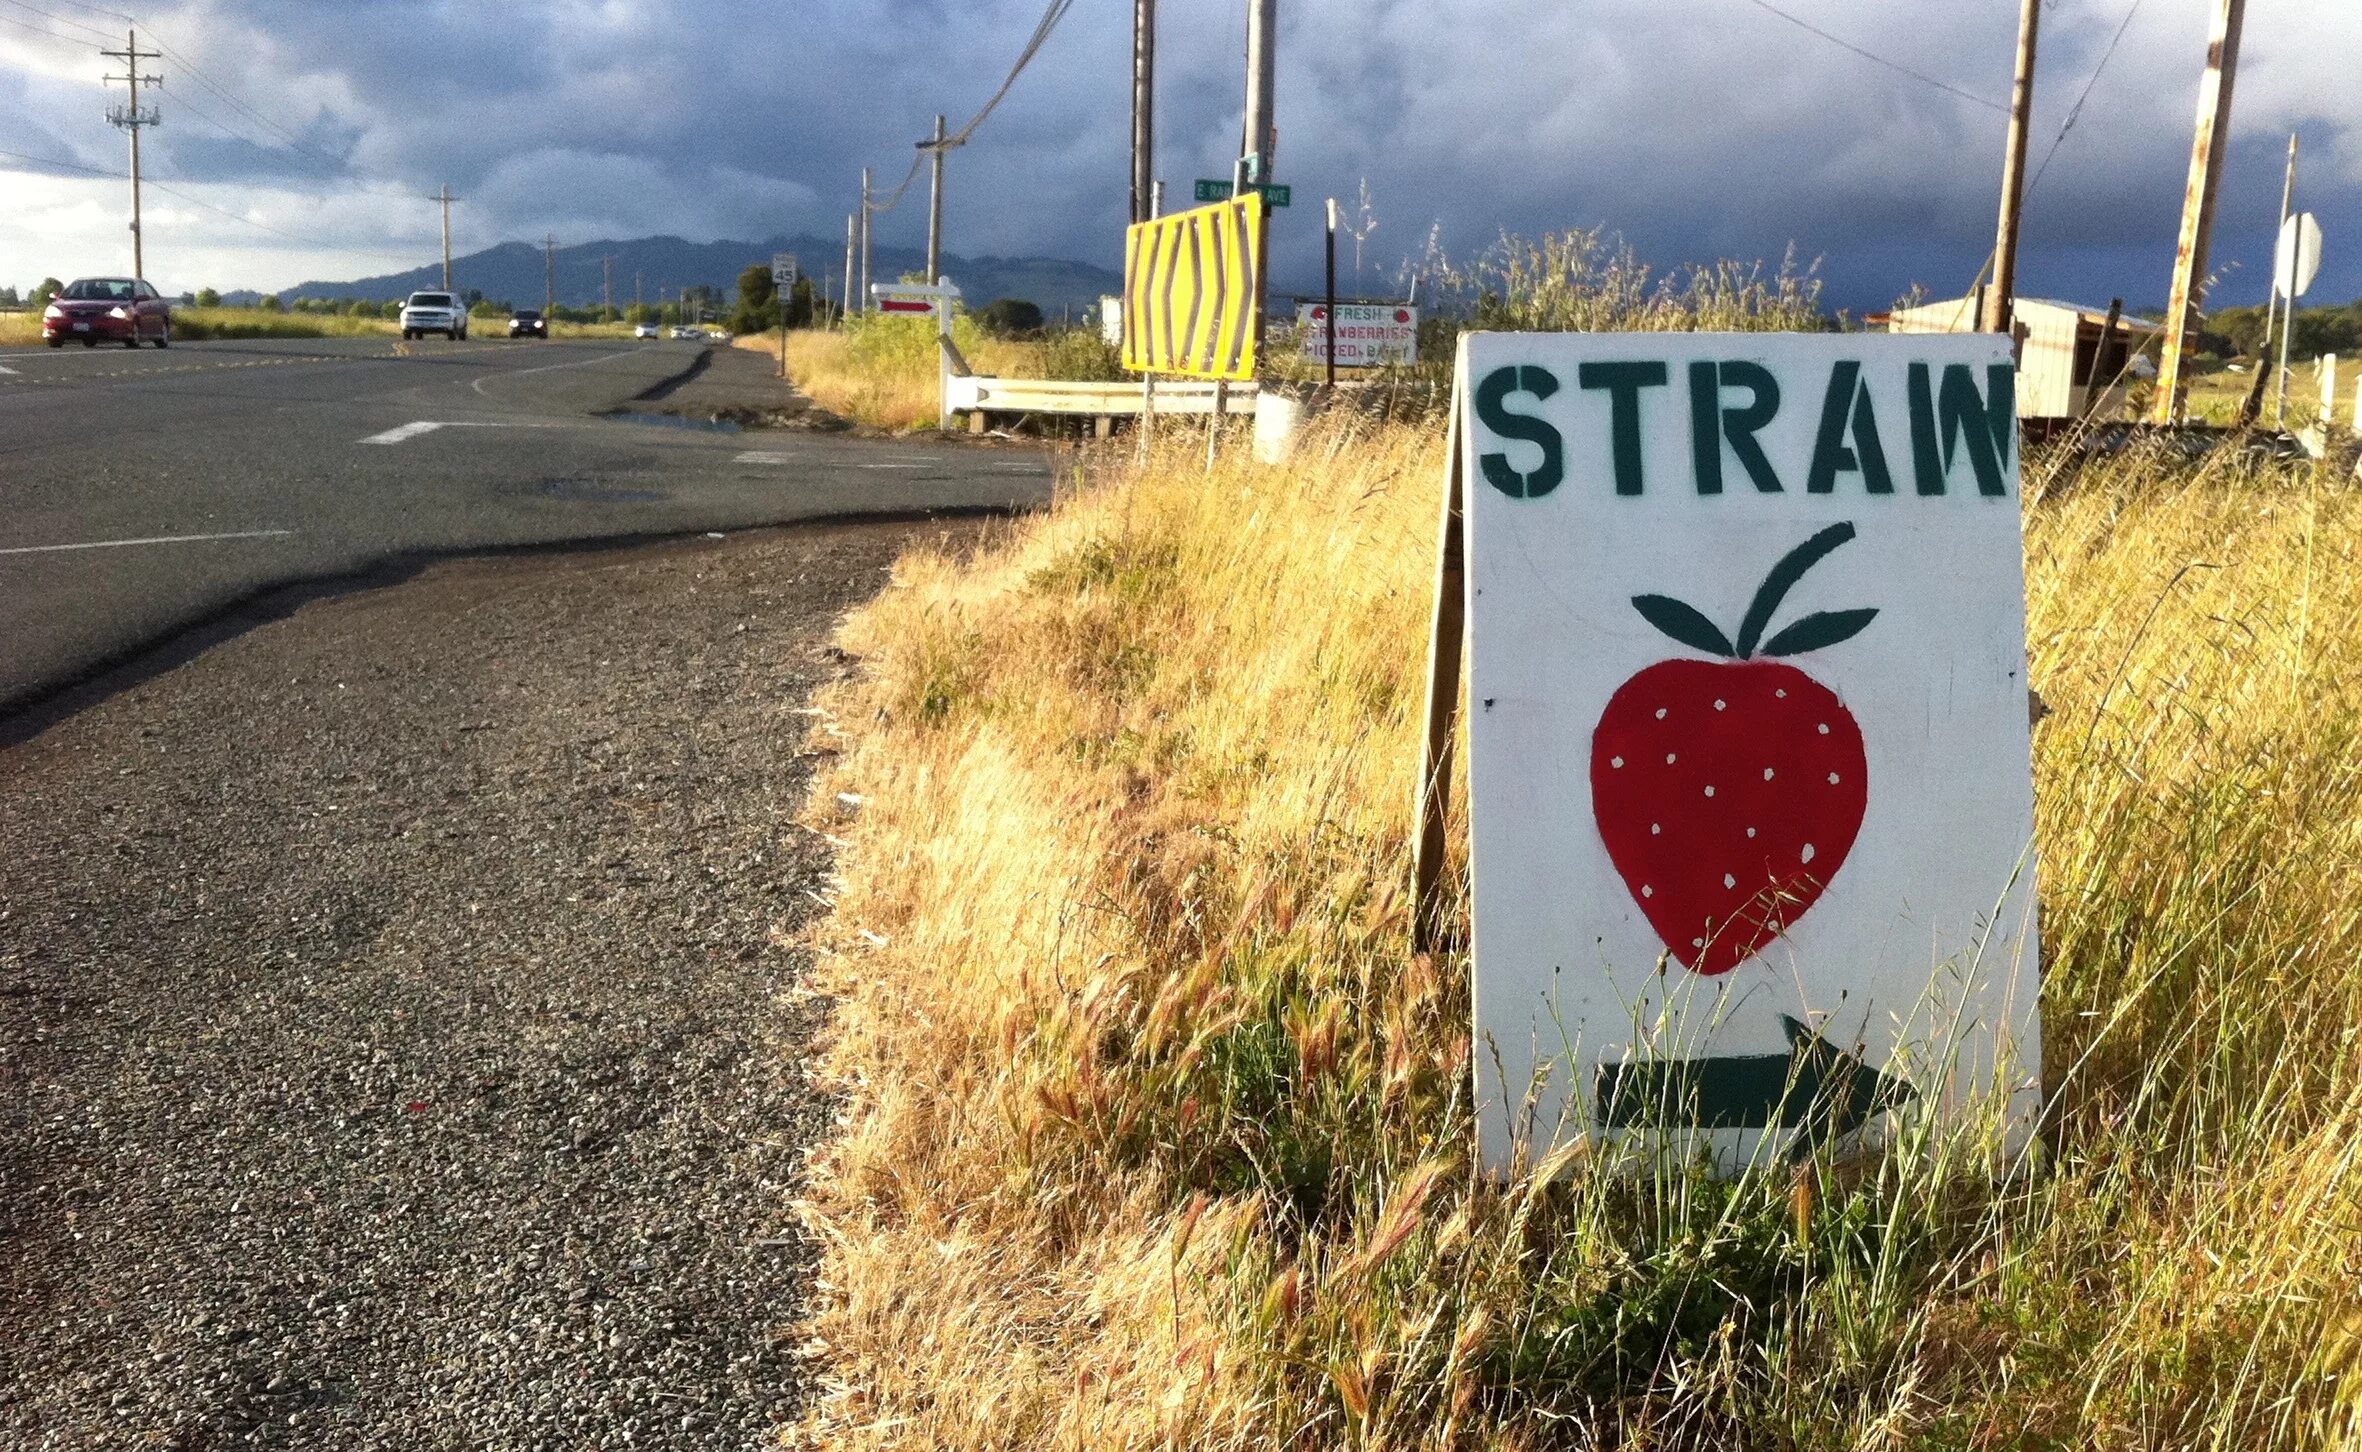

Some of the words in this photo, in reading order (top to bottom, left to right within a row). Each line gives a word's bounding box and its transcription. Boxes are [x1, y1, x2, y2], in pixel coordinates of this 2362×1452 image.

[1267, 187, 1287, 203] AVE
[774, 269, 793, 281] 45
[1334, 307, 1380, 321] FRESH
[1301, 325, 1409, 340] SRWBERRIES
[1475, 360, 2015, 498] STRAW
